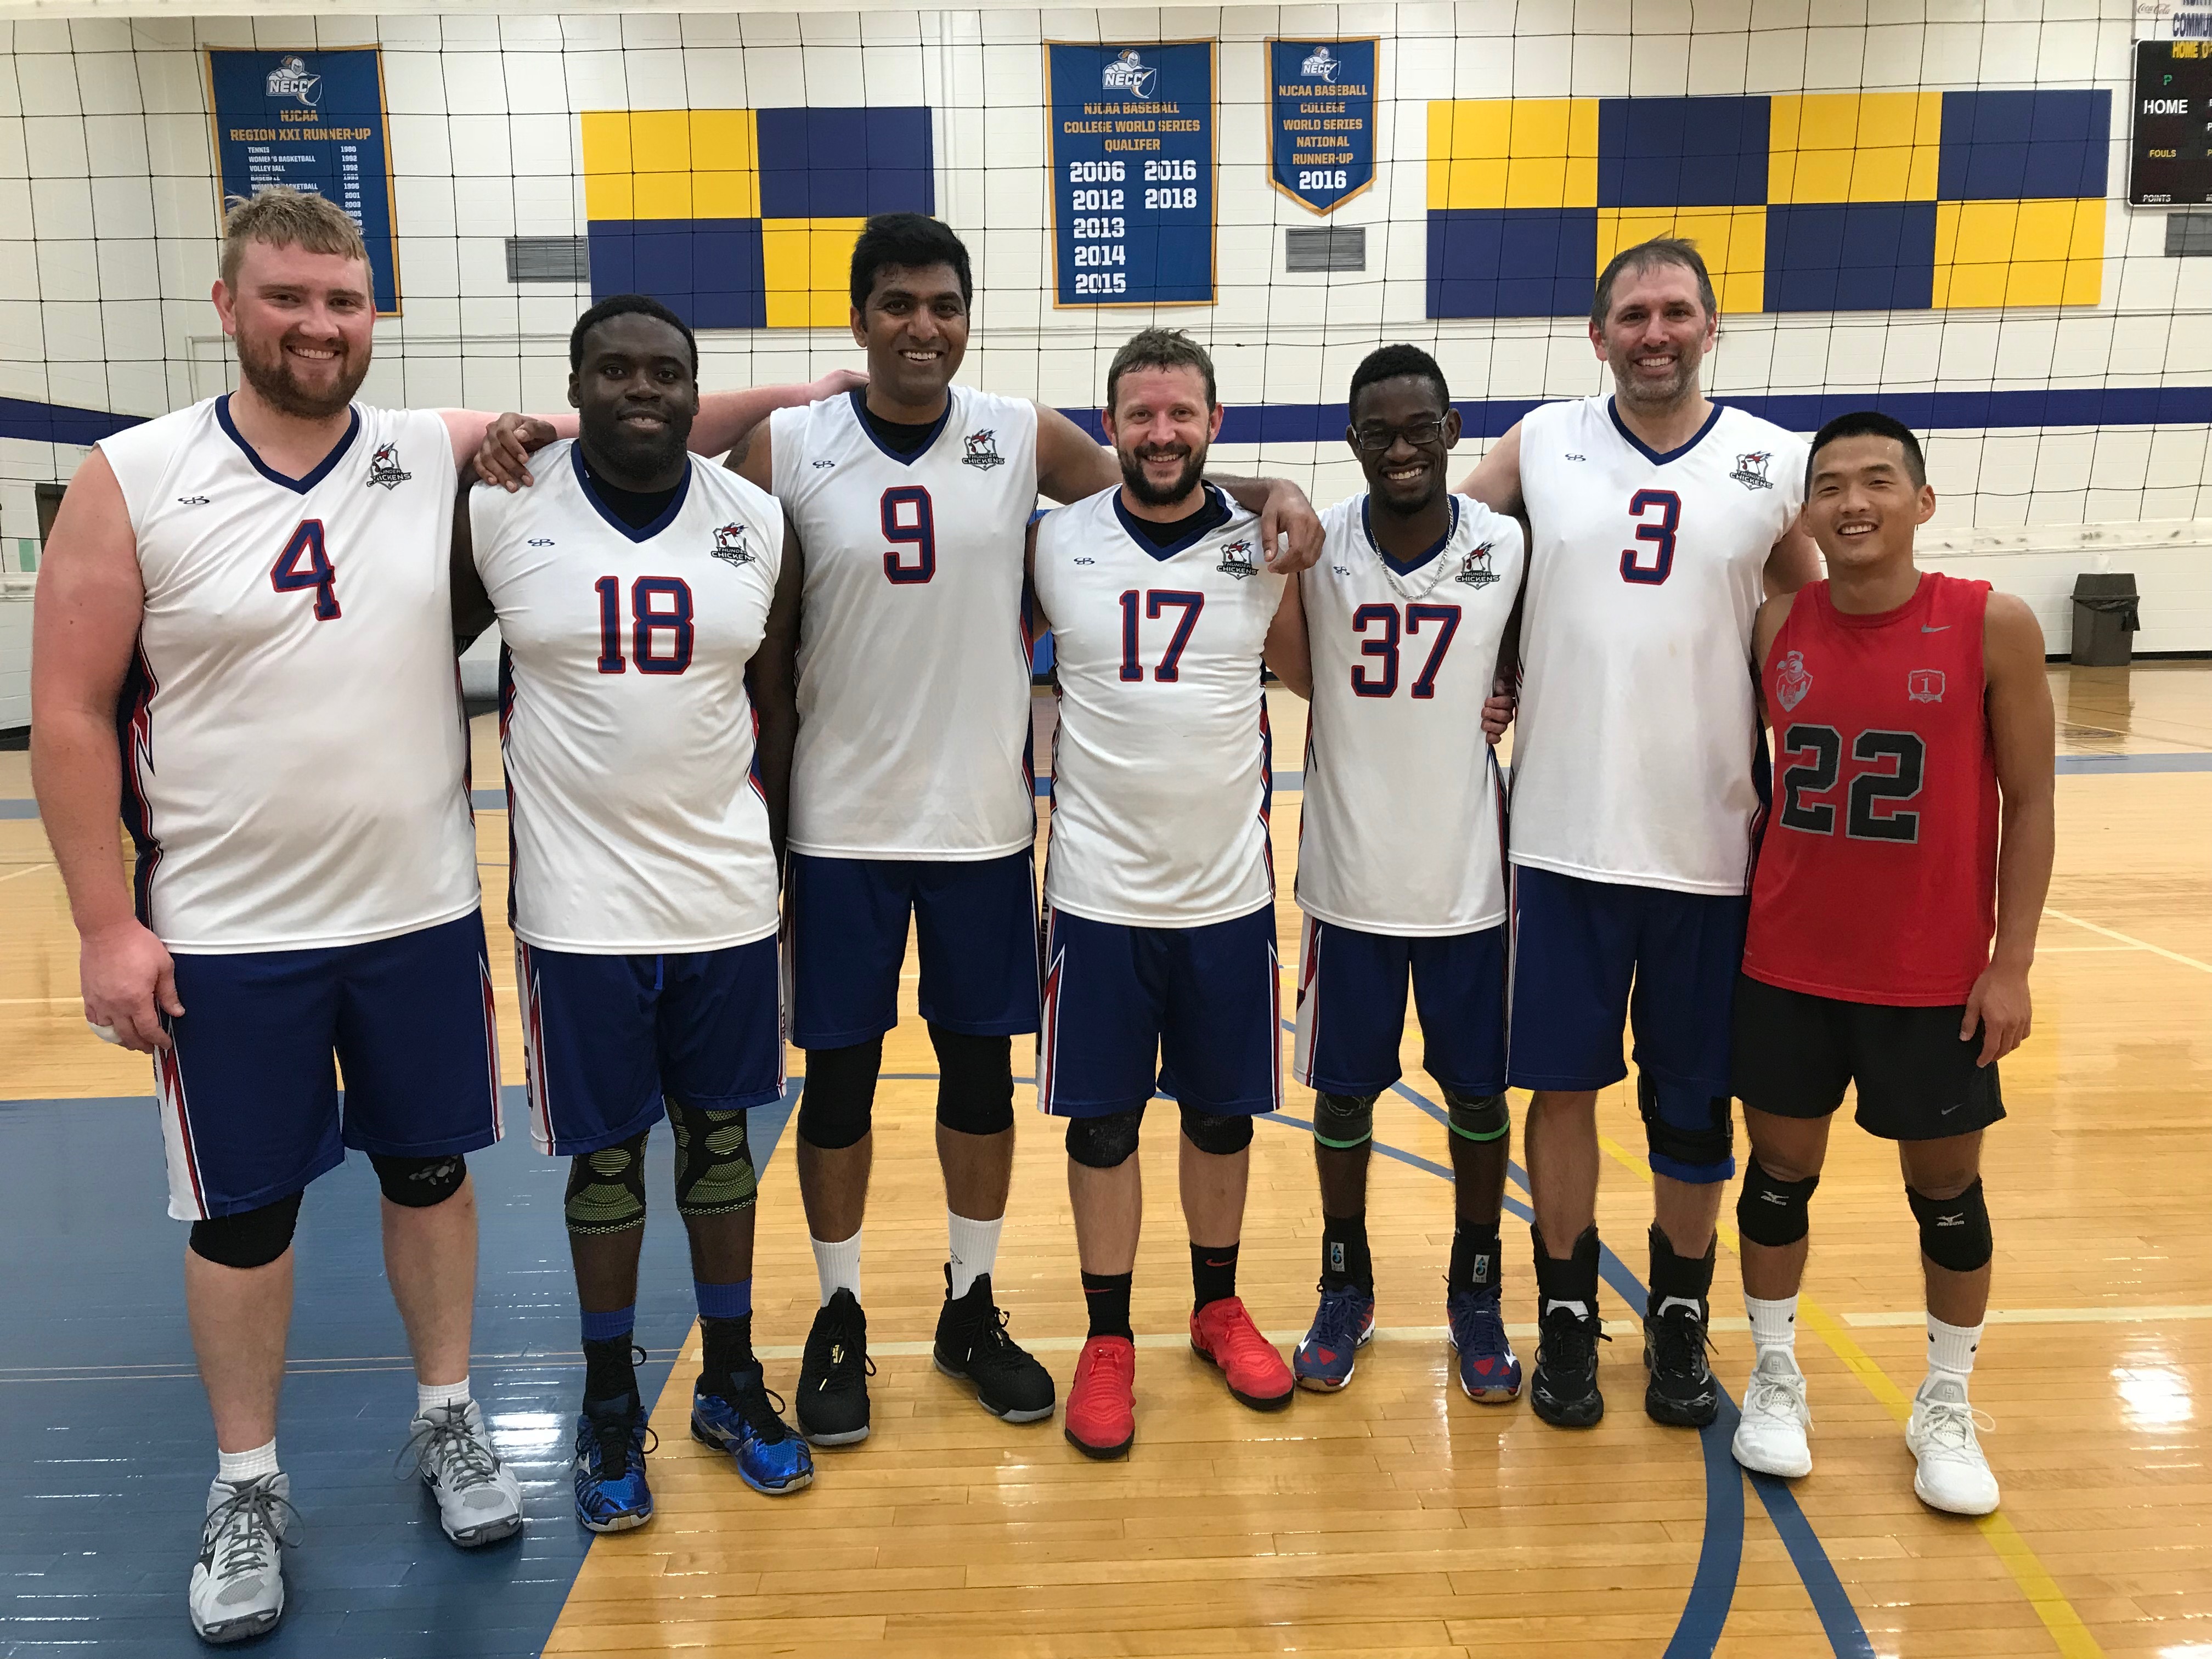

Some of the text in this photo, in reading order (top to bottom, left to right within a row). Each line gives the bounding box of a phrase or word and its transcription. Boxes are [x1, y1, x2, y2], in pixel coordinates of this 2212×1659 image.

[2171, 41, 2199, 58] HOME
[1304, 64, 1330, 74] NECC
[269, 80, 307, 93] NECC
[1105, 73, 1142, 86] NECC
[2163, 75, 2172, 86] P
[1279, 84, 1367, 96] NJCAA BASEBALL
[1084, 101, 1180, 115] NJCAA BASEBALL
[1300, 102, 1345, 113] COLLEGE
[2143, 99, 2188, 114] HOME
[280, 110, 318, 122] NJCAA
[1064, 120, 1200, 133] COLLEGE WORLD SERIES
[1283, 119, 1362, 131] WORLD SERIES
[230, 128, 371, 141] REGION XXI RUNNER-UP
[1296, 136, 1350, 148] NATIONAL
[1105, 138, 1160, 153] QUALIFER
[2149, 149, 2176, 157] FOULS
[1293, 153, 1353, 165] RUNNER-UP
[1070, 161, 1126, 183] 2006
[1144, 160, 1197, 181] 2016
[1299, 170, 1347, 189] 2016
[1073, 189, 1125, 210] 2012
[1145, 188, 1197, 209] 2018
[2142, 194, 2171, 202] POINTS
[1074, 217, 1125, 239] 2013
[1074, 245, 1126, 266] 2014
[1075, 273, 1126, 294] 2015
[1730, 473, 1772, 488] CHICKENS
[1737, 471, 1765, 482] THUNDER
[880, 485, 935, 584] 9
[1620, 489, 1681, 585] 3
[712, 551, 753, 561] CHICKEN
[270, 518, 342, 621] 4
[1217, 566, 1257, 575] CHICKENS
[595, 575, 694, 675] 18
[1119, 589, 1204, 682] 17
[1351, 603, 1462, 699] 37
[1921, 677, 1931, 693] 1
[1779, 723, 1926, 844] 22
